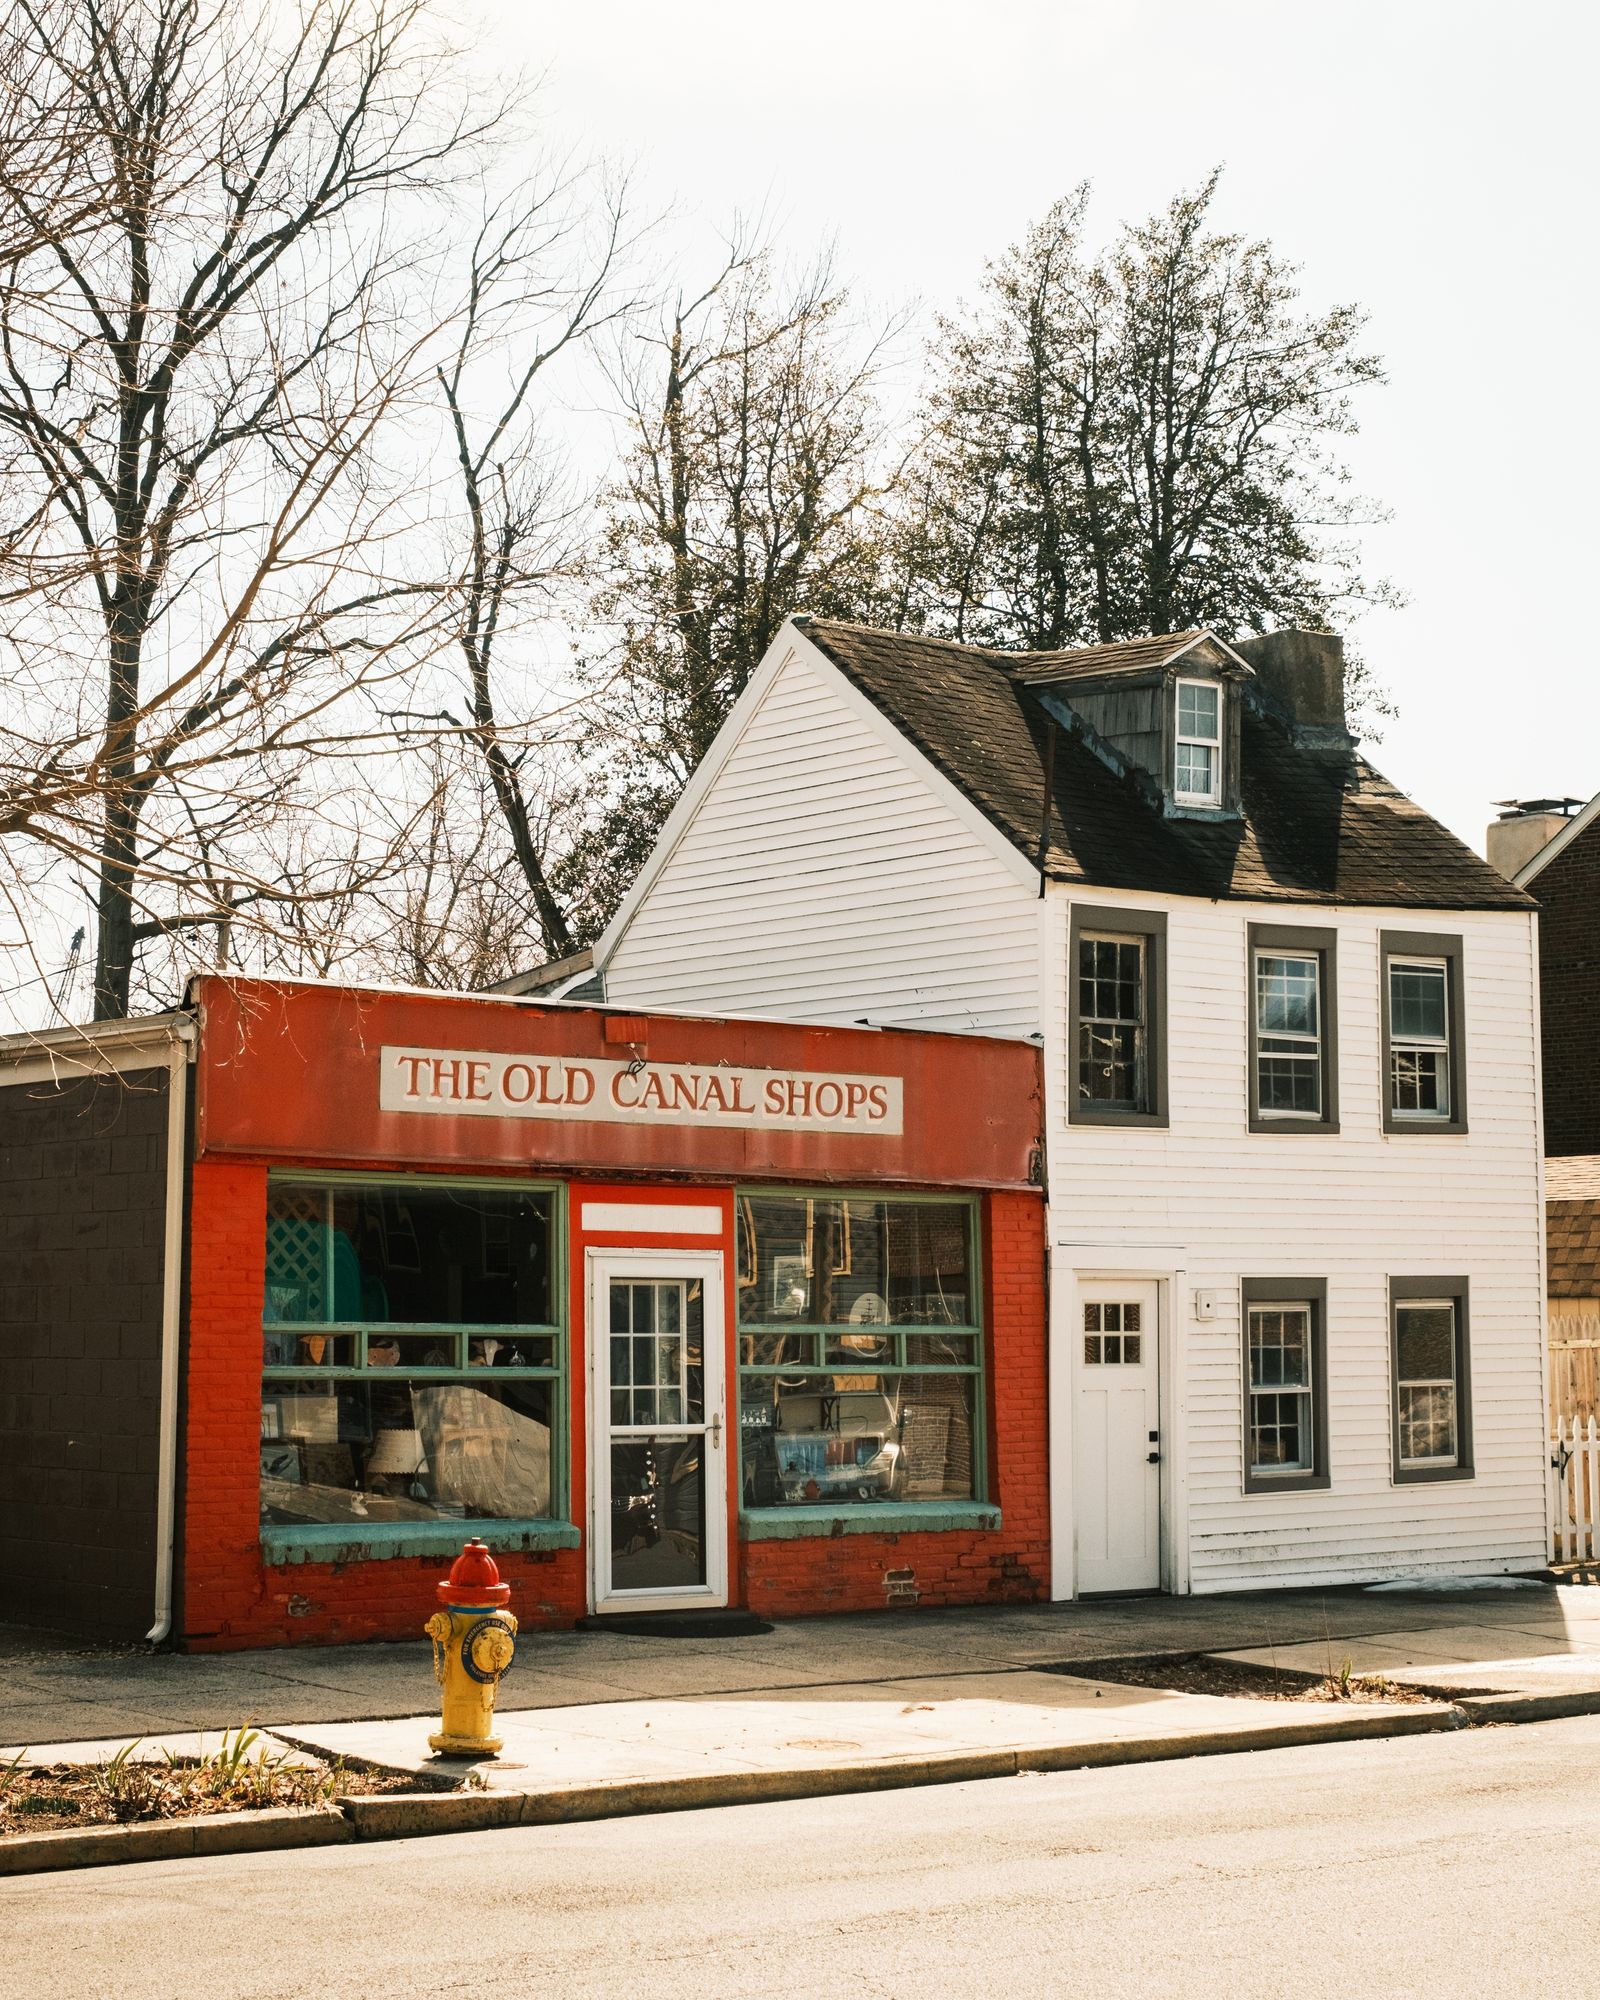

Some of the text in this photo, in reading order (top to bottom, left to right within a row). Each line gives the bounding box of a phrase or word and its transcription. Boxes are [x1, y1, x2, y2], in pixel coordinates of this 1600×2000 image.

[396, 1055, 888, 1120] THE OLD CANAL SHOPS
[466, 1620, 490, 1642] EMERGENCY
